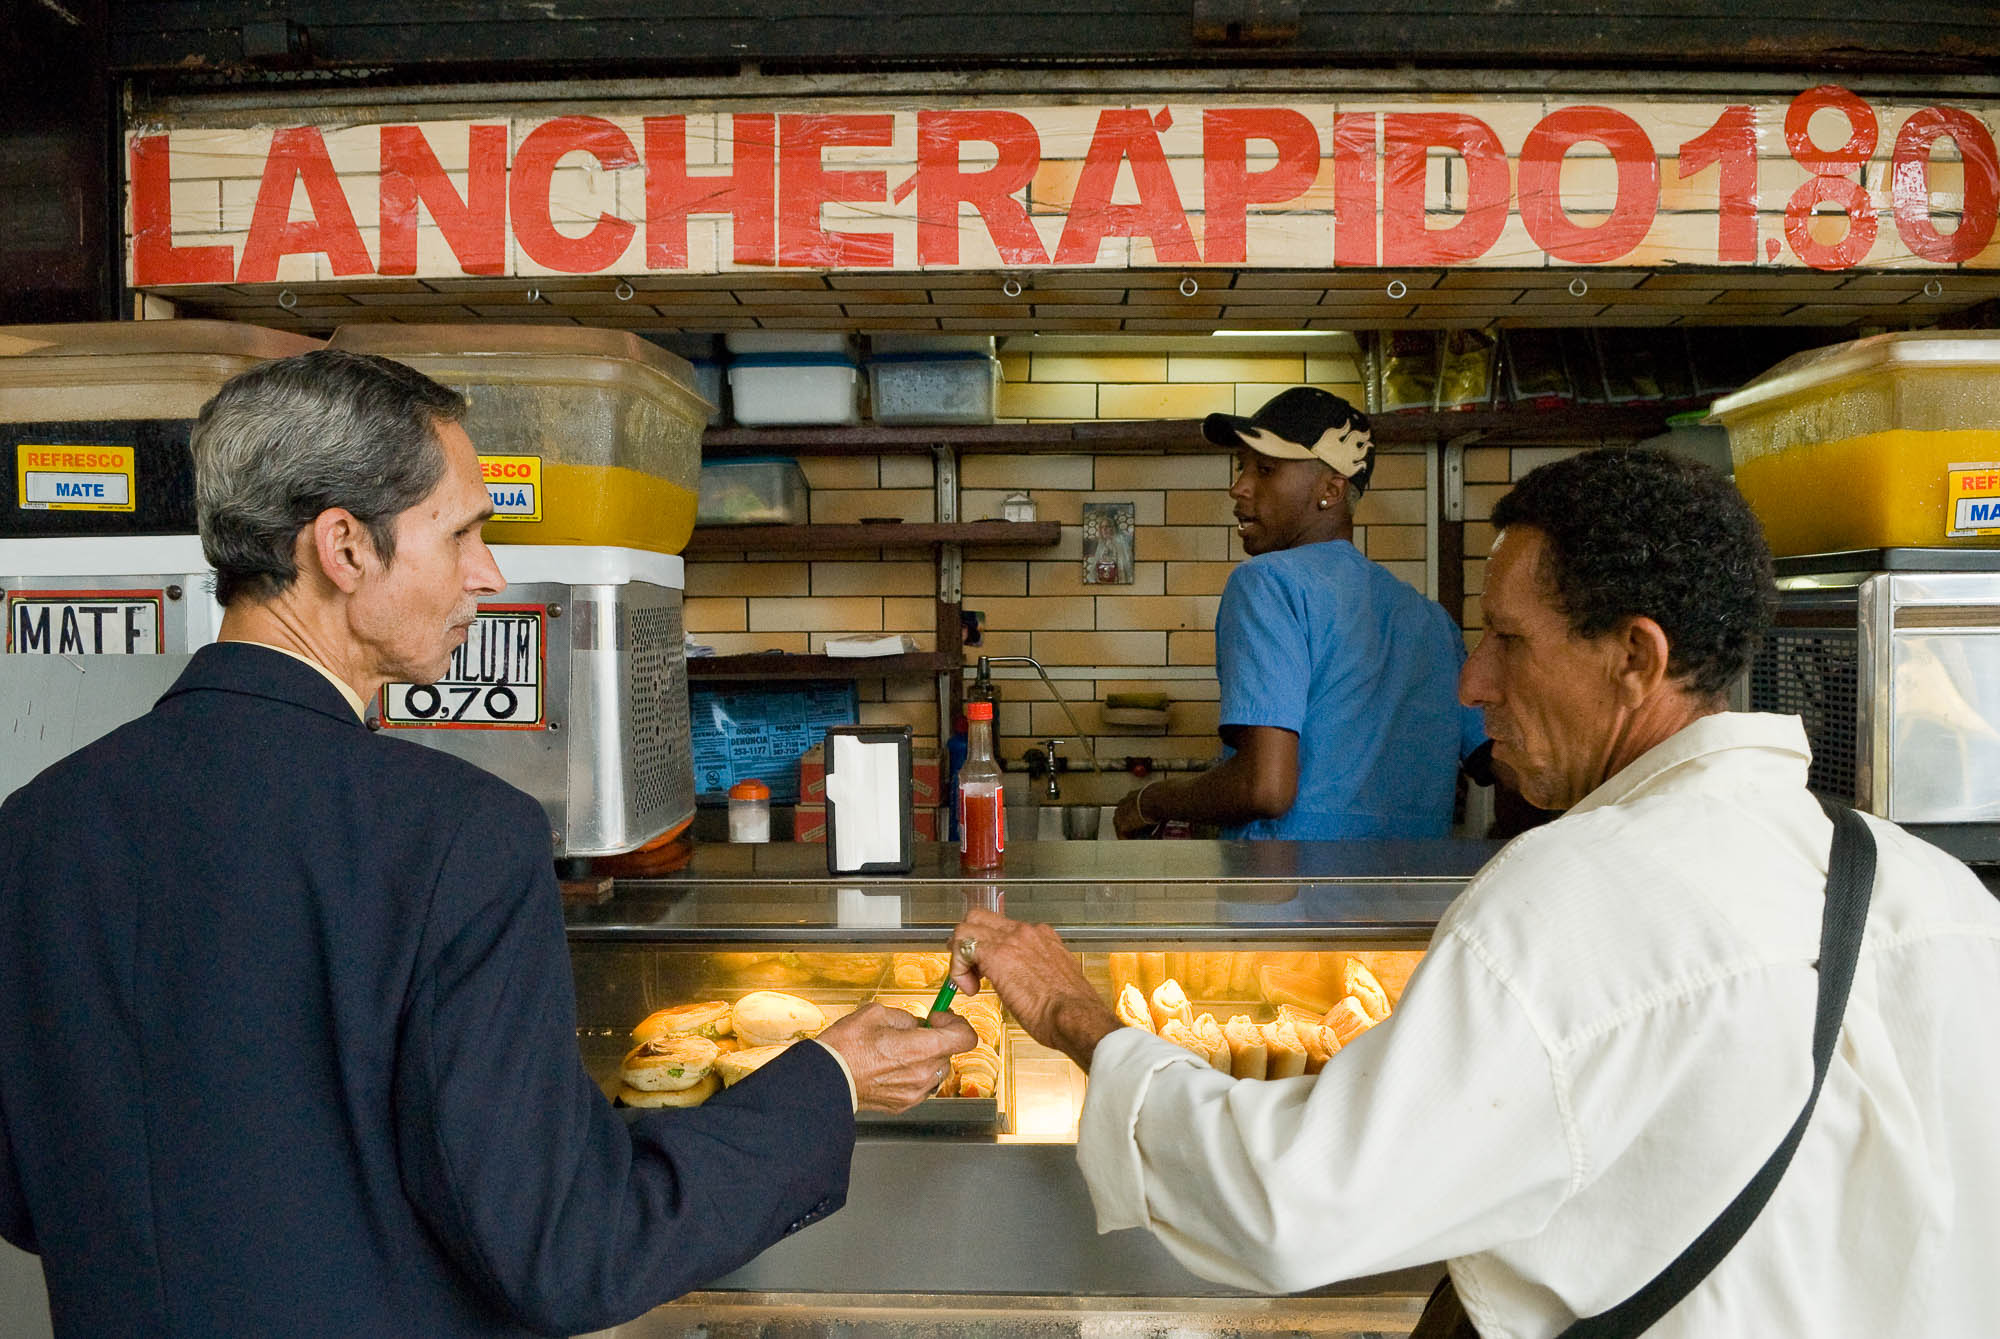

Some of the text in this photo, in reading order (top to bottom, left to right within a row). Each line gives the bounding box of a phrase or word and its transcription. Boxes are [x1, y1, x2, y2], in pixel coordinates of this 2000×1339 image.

[130, 114, 895, 287] LANCHE
[917, 104, 1657, 267] RÁPIDO
[27, 452, 125, 469] REFRESCO
[480, 463, 531, 478] ESCO
[55, 482, 105, 498] MATE
[1961, 475, 2000, 491] REF
[488, 489, 527, 507] UJÁ
[404, 683, 519, 721] 0,70
[731, 735, 768, 746] DENÚNCIA
